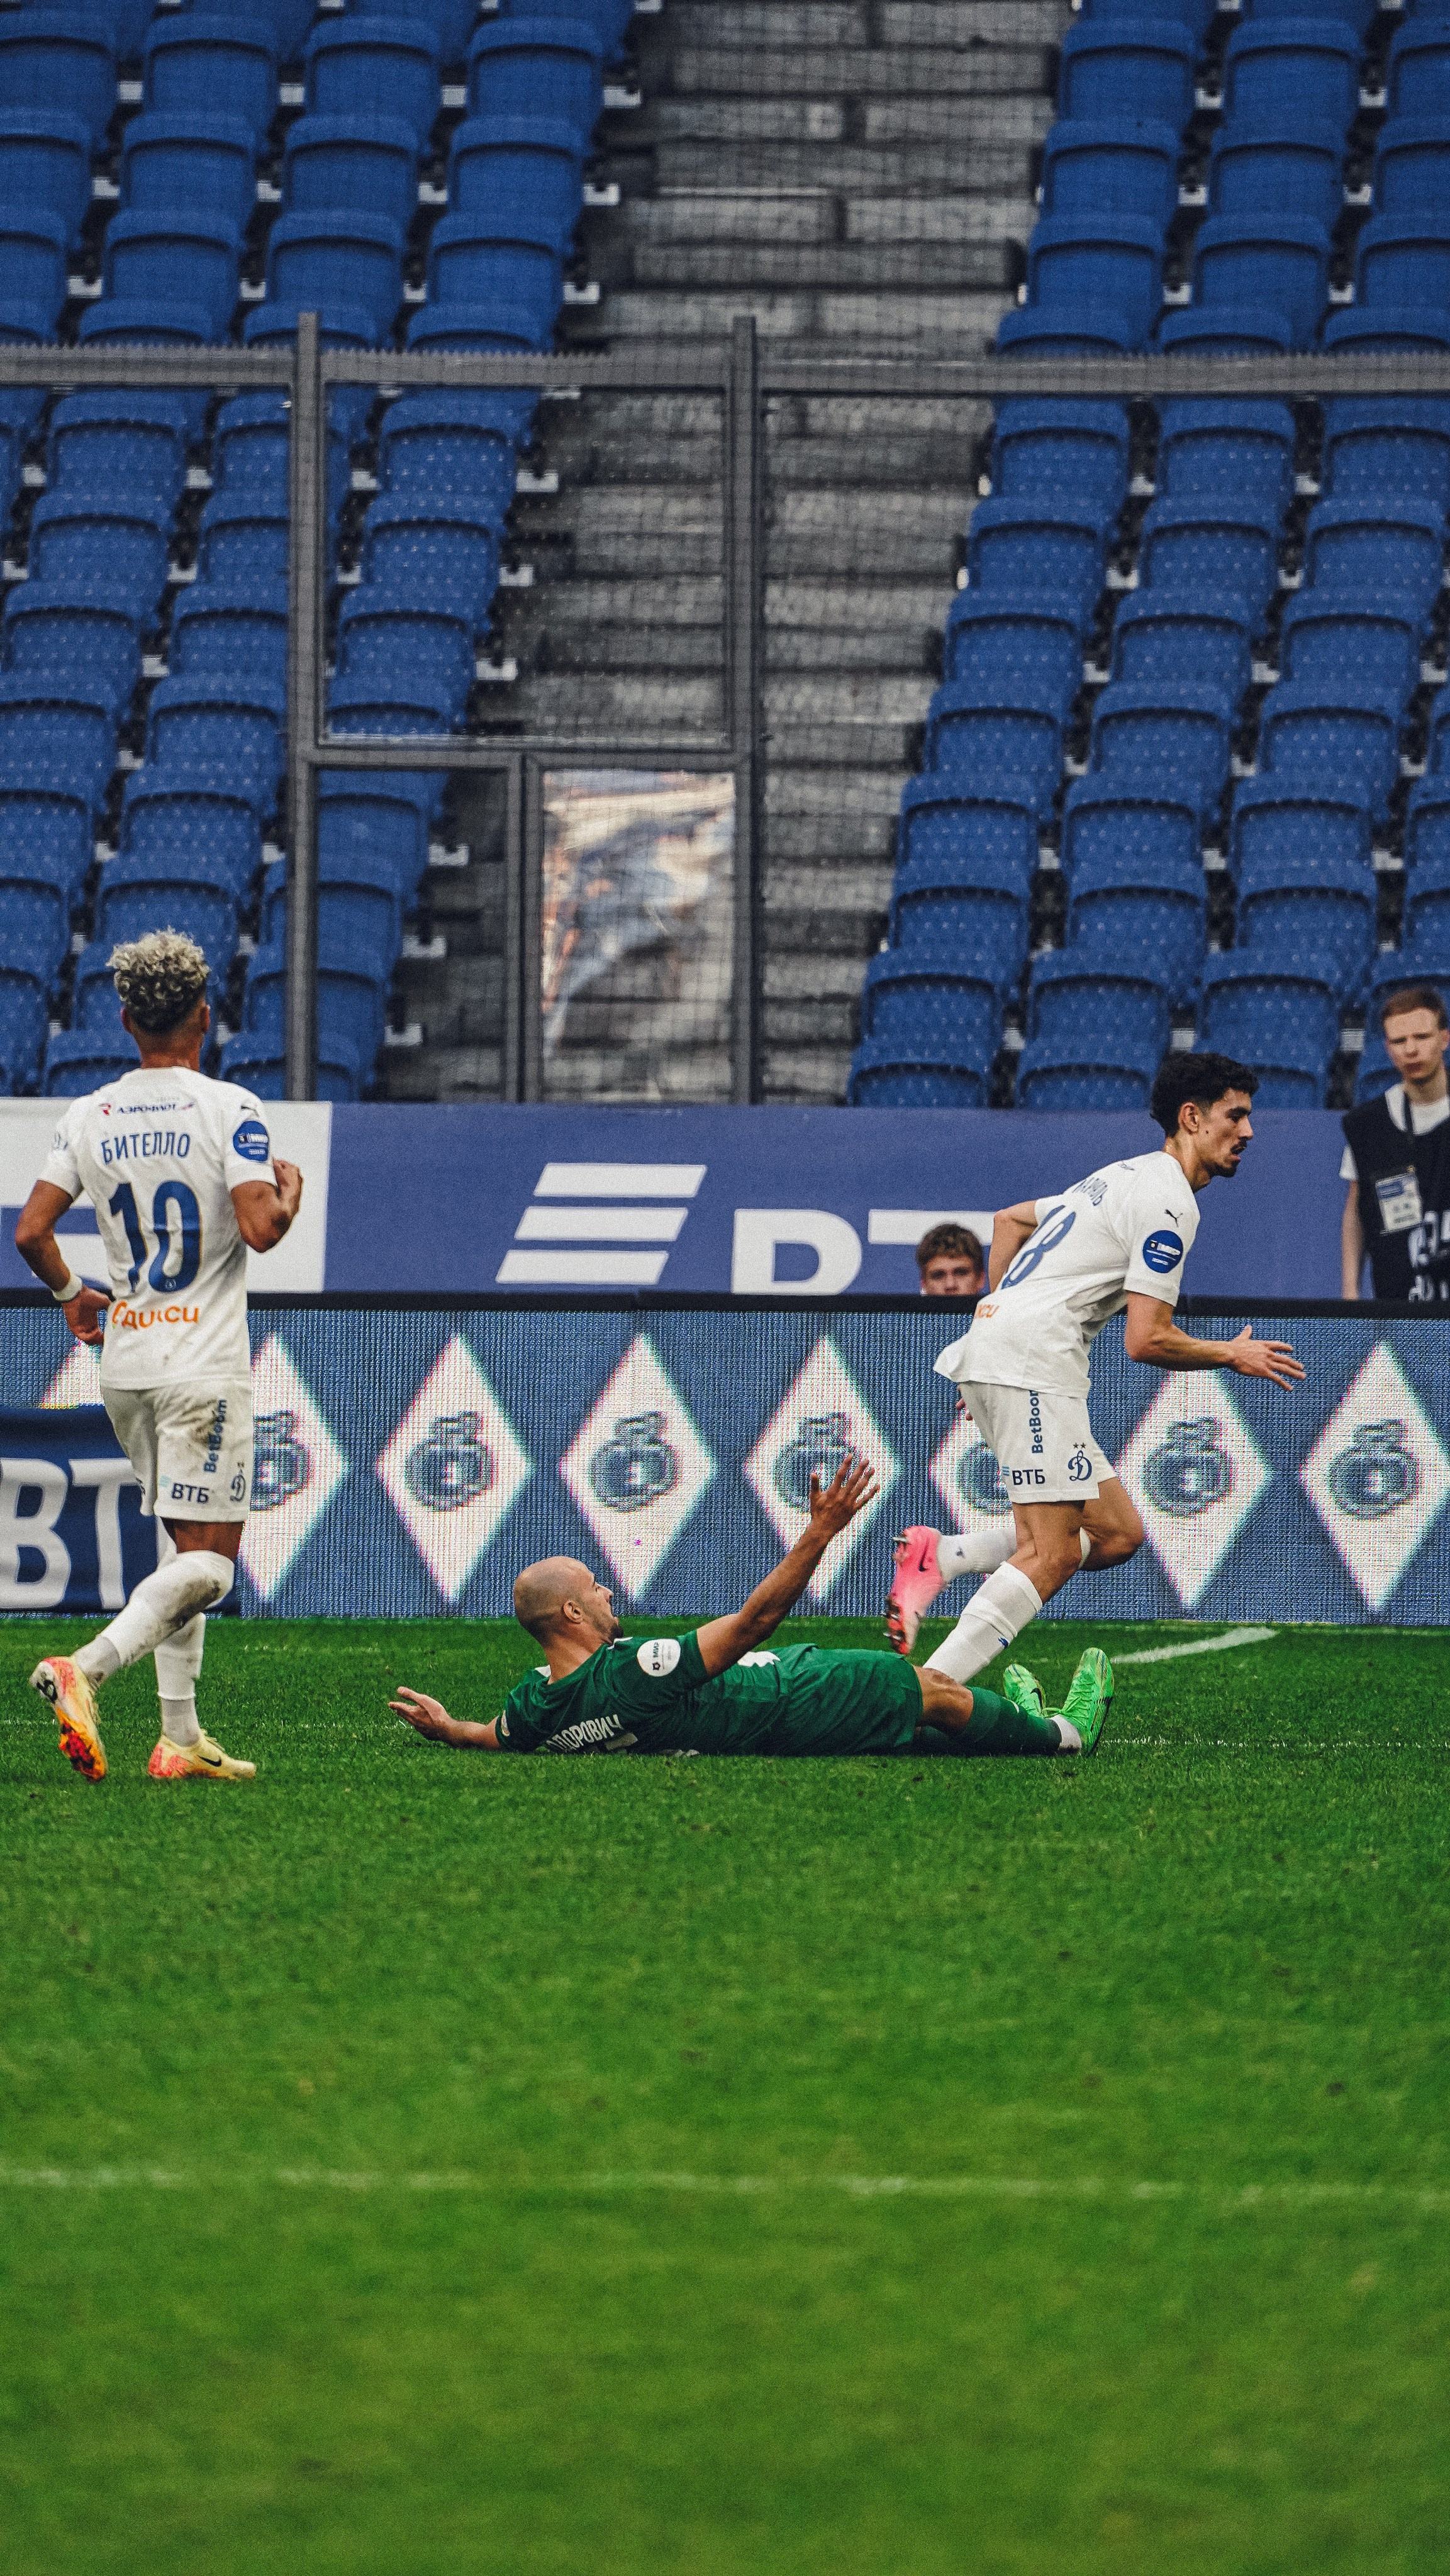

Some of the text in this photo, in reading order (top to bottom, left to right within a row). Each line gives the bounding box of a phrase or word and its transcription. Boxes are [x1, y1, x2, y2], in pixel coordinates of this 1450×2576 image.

[101, 1131, 191, 1165] БИТЕЛЛО
[108, 1180, 201, 1294] 10
[203, 1399, 227, 1473] BetBoom
[170, 1482, 210, 1504] ВТБ
[1012, 1468, 1046, 1485] ВТБ
[0, 1457, 174, 1609] ВТ
